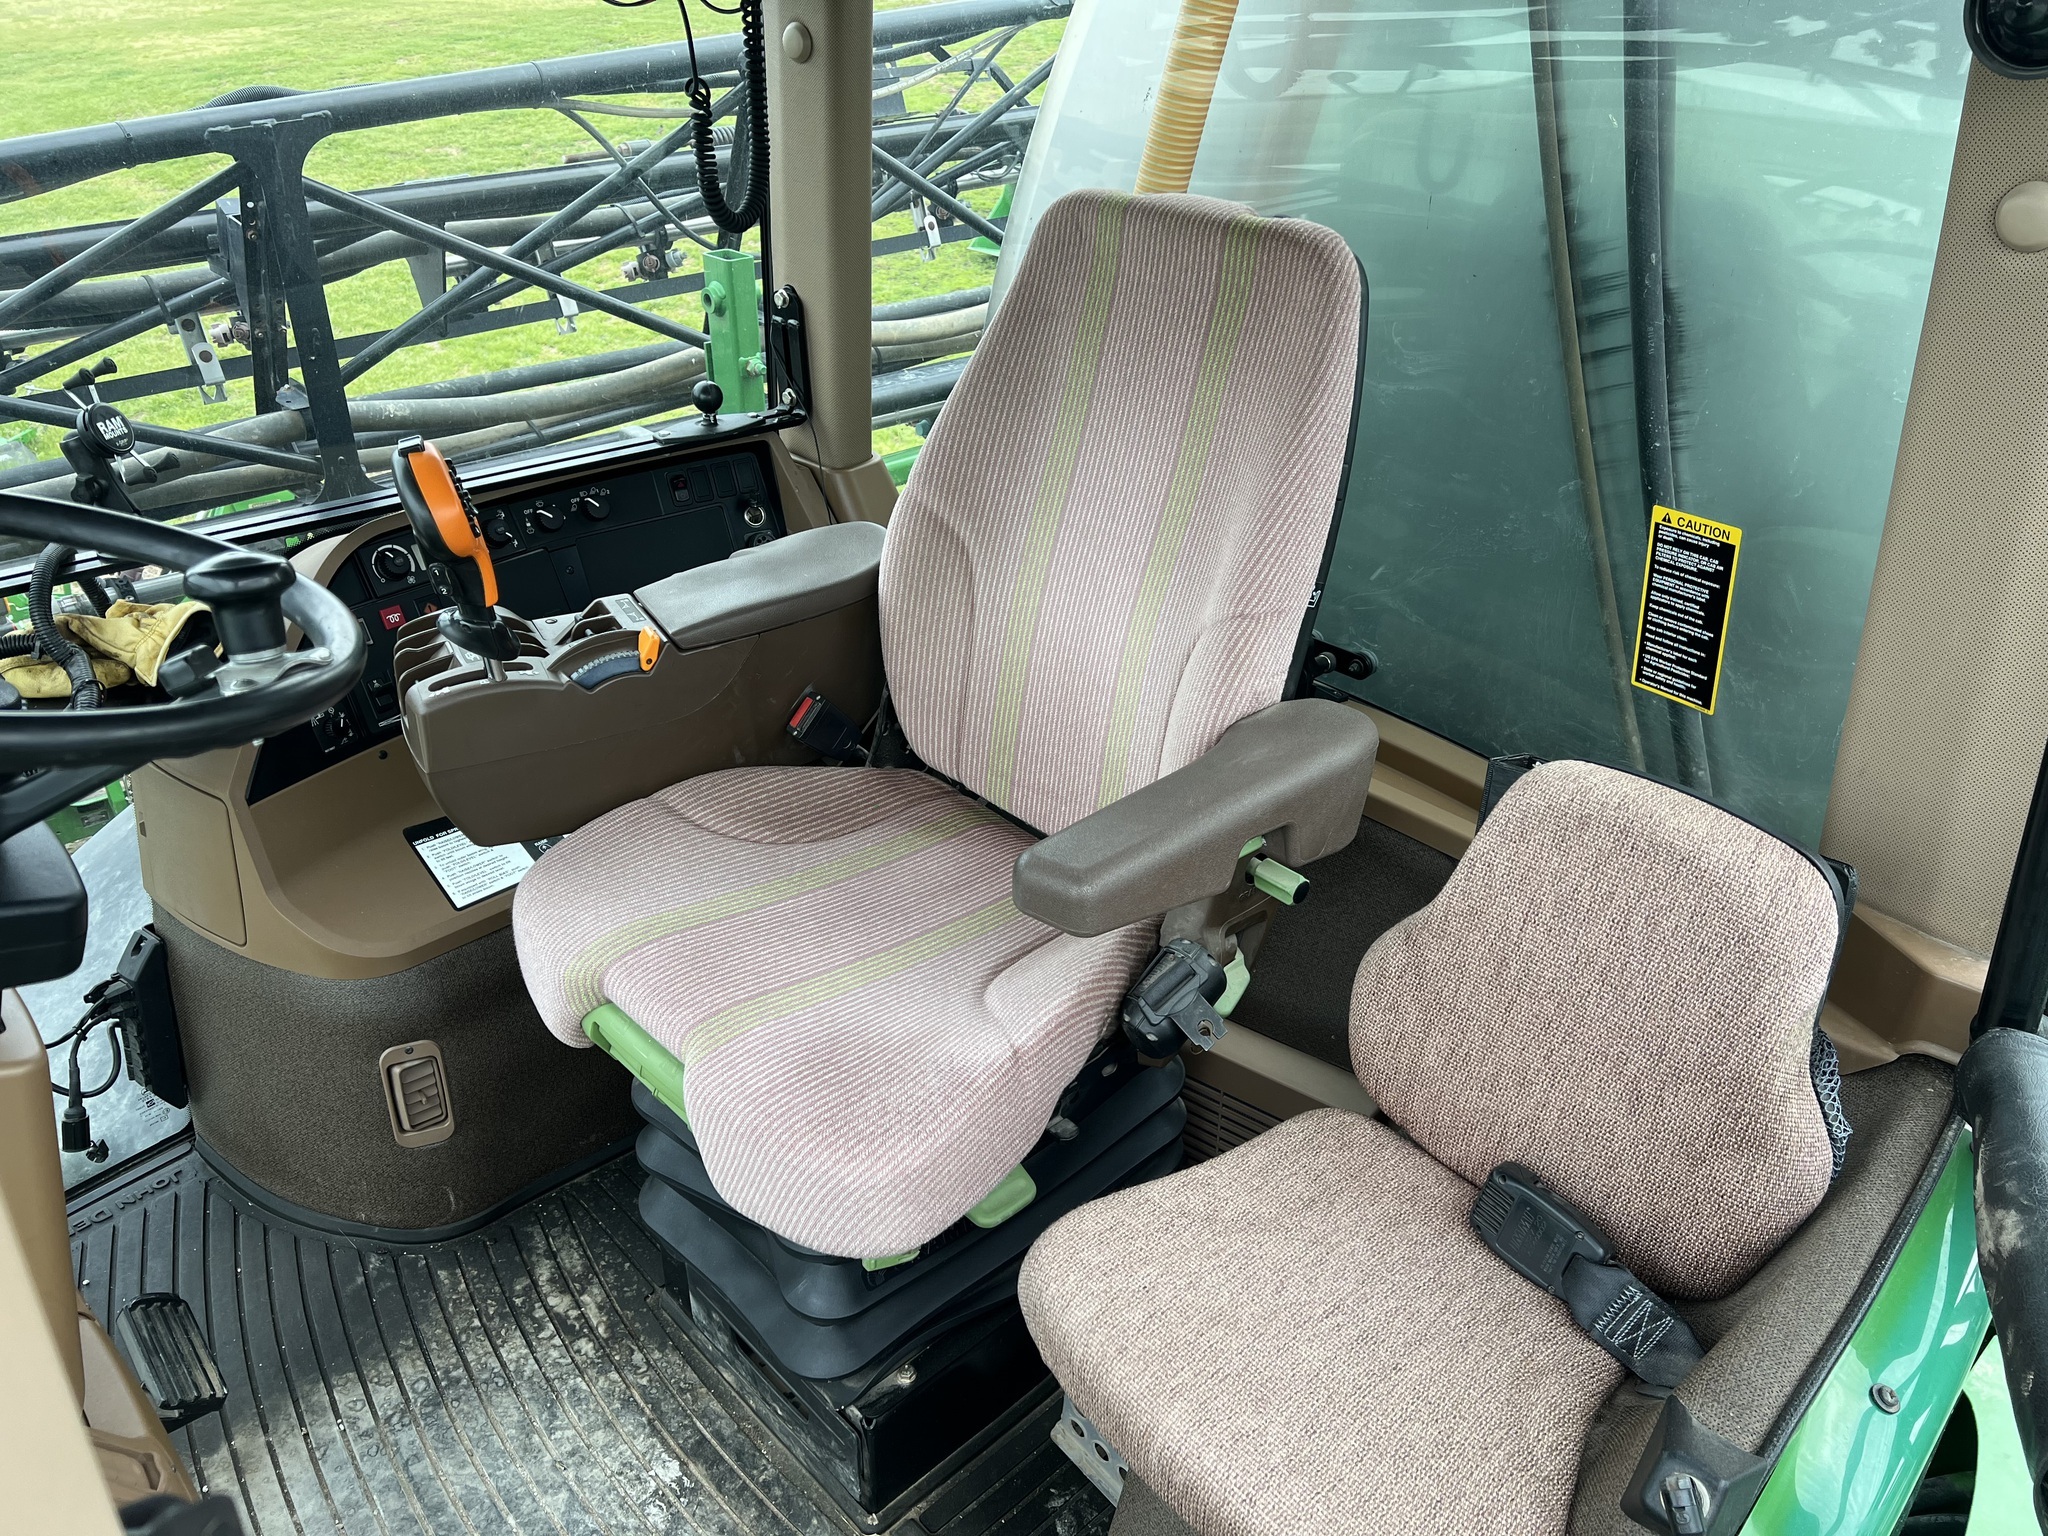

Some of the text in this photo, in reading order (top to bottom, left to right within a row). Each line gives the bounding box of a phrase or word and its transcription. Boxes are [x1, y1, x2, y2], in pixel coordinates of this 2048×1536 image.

[96, 415, 124, 433] RAM
[103, 427, 128, 440] MOUNTS
[1677, 517, 1730, 541] CAUTION
[412, 835, 435, 845] UNFOLD
[435, 830, 448, 838] FOR
[115, 1170, 182, 1209] JOHN
